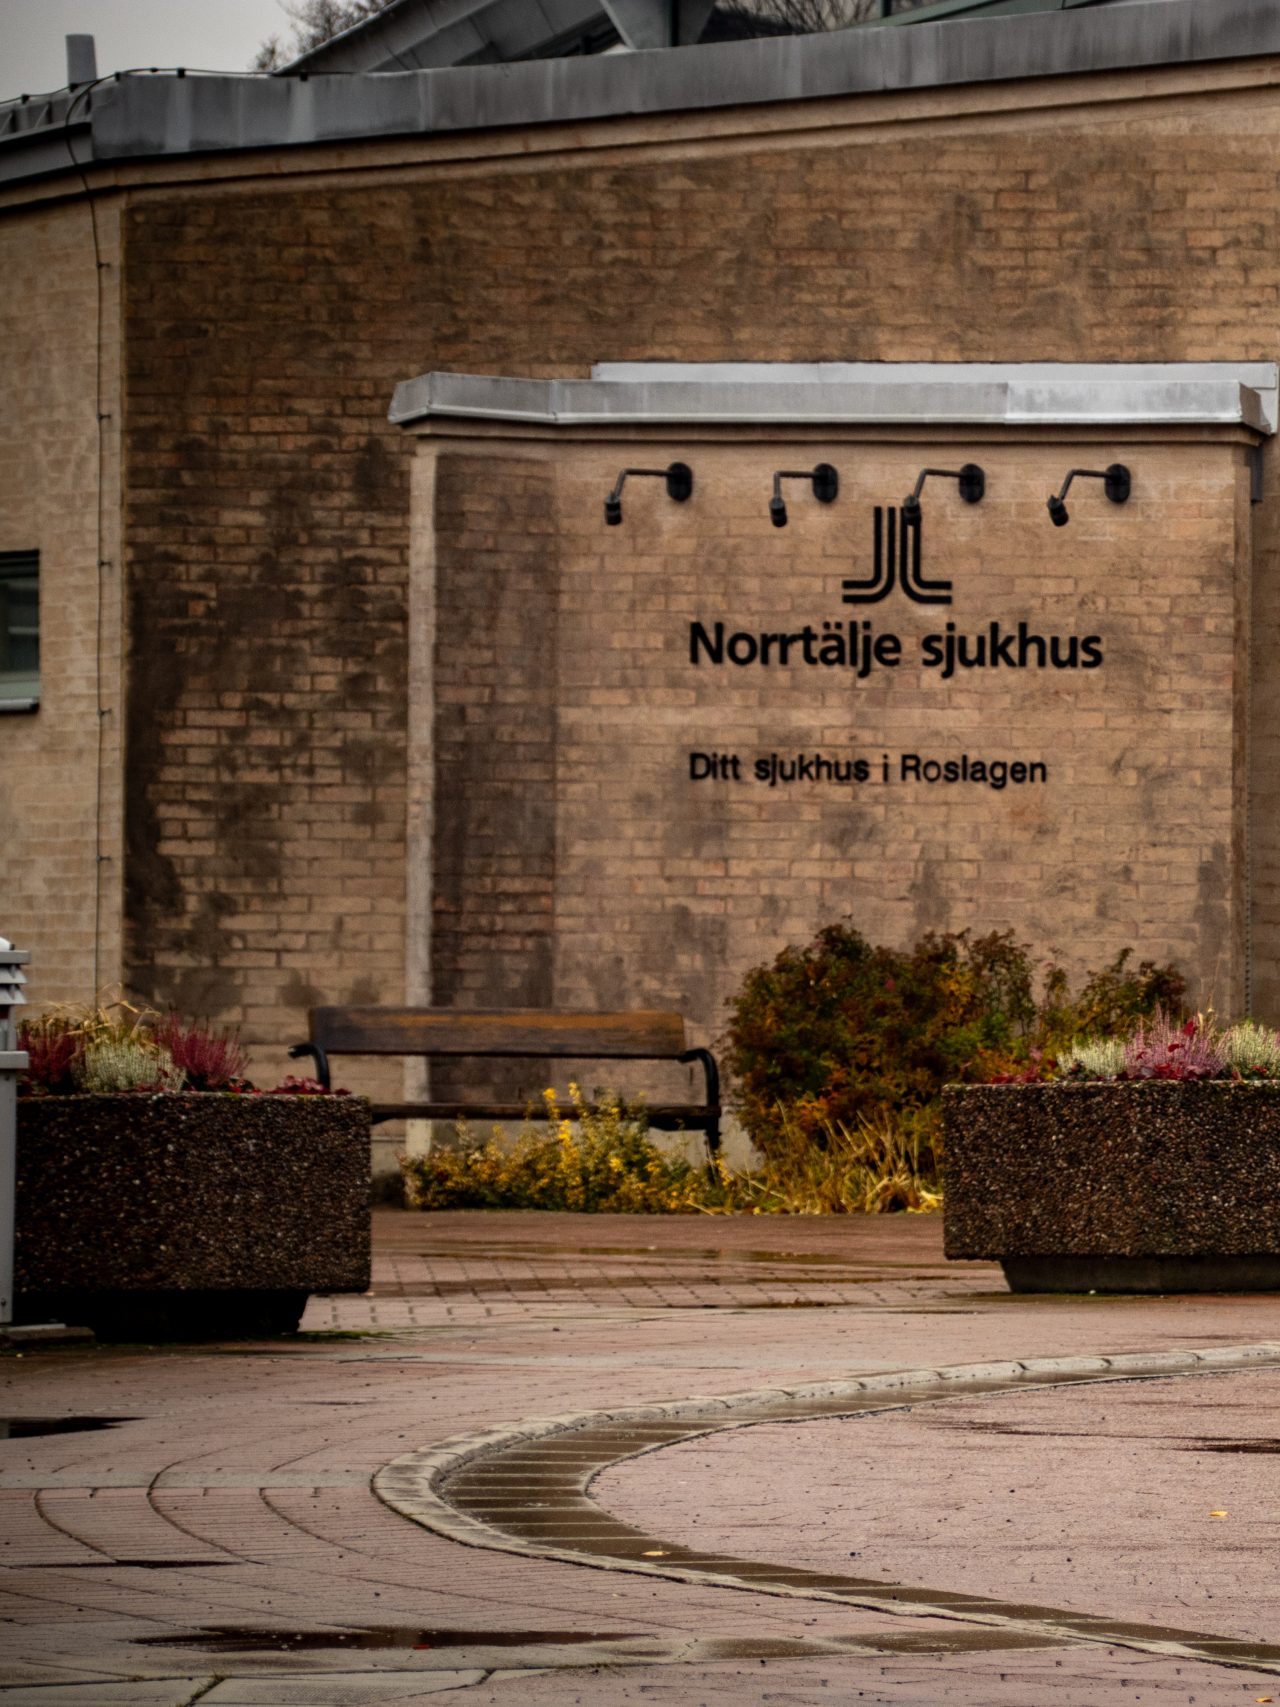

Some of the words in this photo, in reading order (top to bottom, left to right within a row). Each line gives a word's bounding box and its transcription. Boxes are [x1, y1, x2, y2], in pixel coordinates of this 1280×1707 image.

[689, 621, 902, 678] Norrtälje
[921, 621, 1103, 678] sjukhus
[689, 752, 741, 781] Ditt
[754, 752, 870, 787] sjukhus
[882, 753, 889, 782] i
[900, 753, 1047, 789] Roslagen
